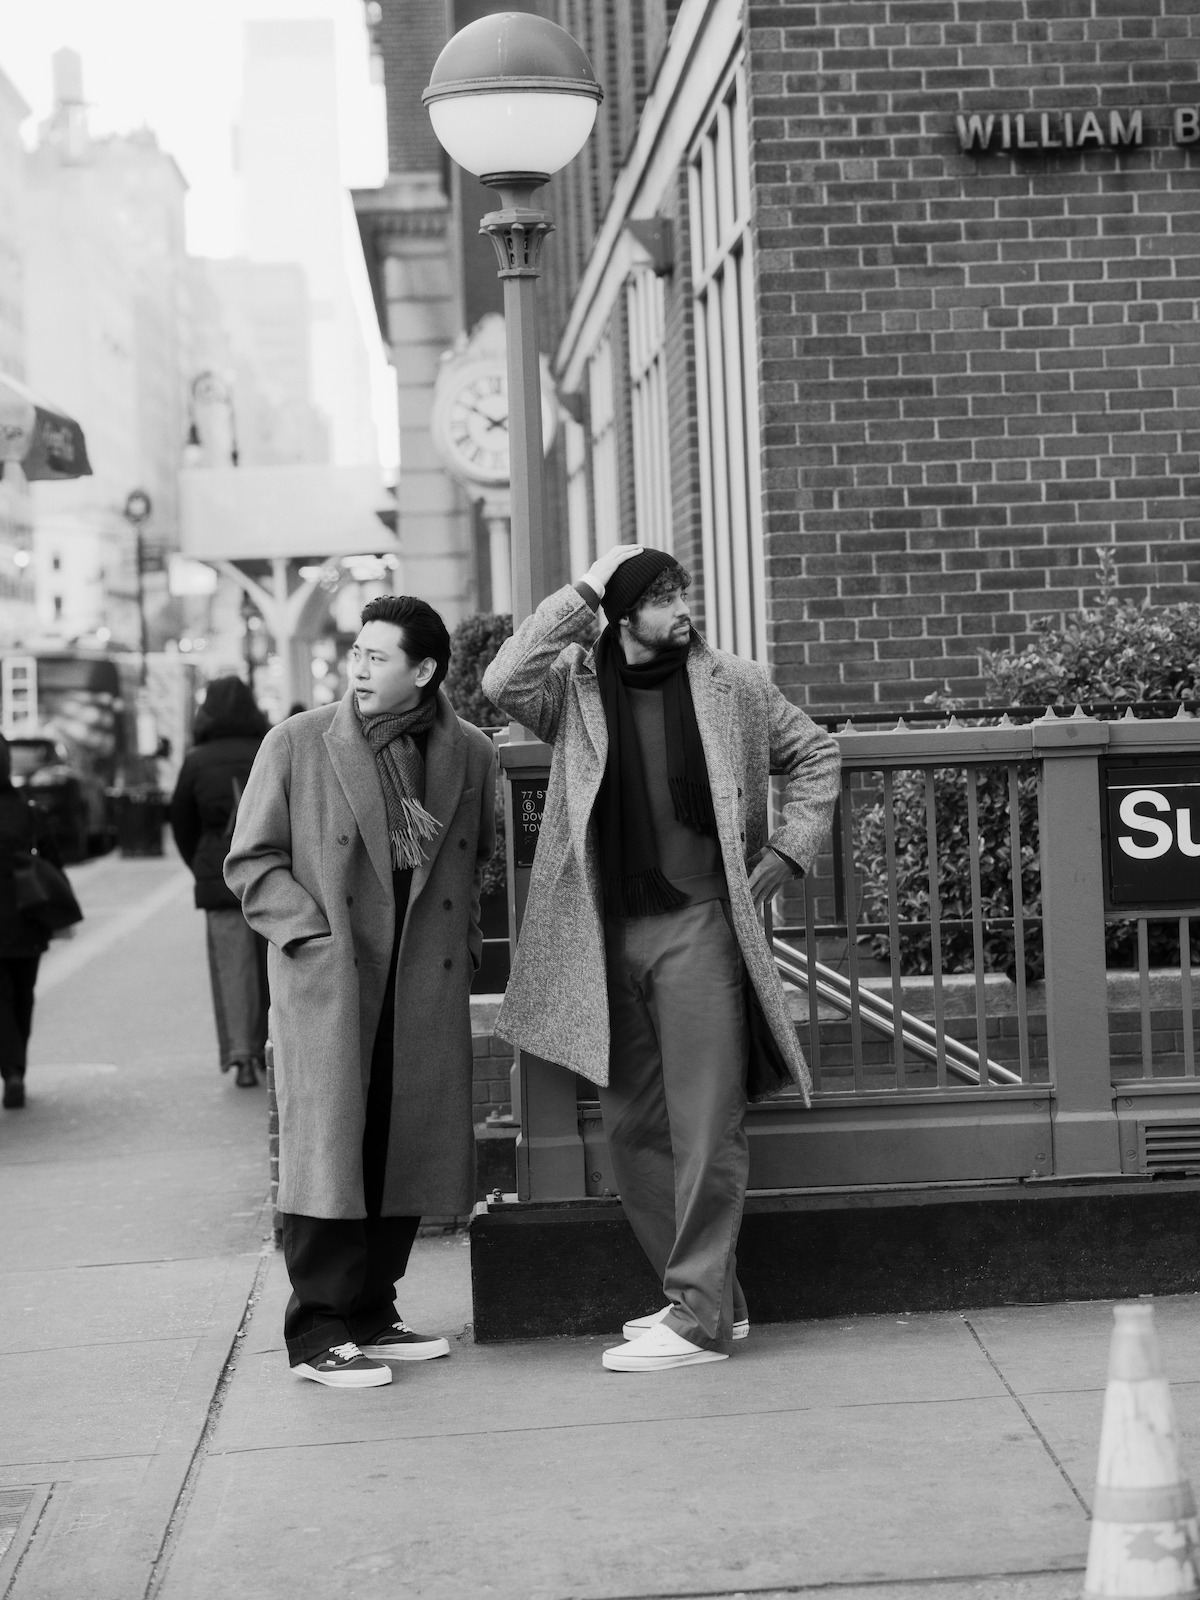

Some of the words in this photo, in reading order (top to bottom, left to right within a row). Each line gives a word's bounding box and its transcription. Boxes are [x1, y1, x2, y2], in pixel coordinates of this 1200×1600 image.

[957, 110, 1143, 149] WILLIAM
[1174, 107, 1200, 143] B
[521, 791, 533, 799] 77
[522, 824, 540, 832] TO
